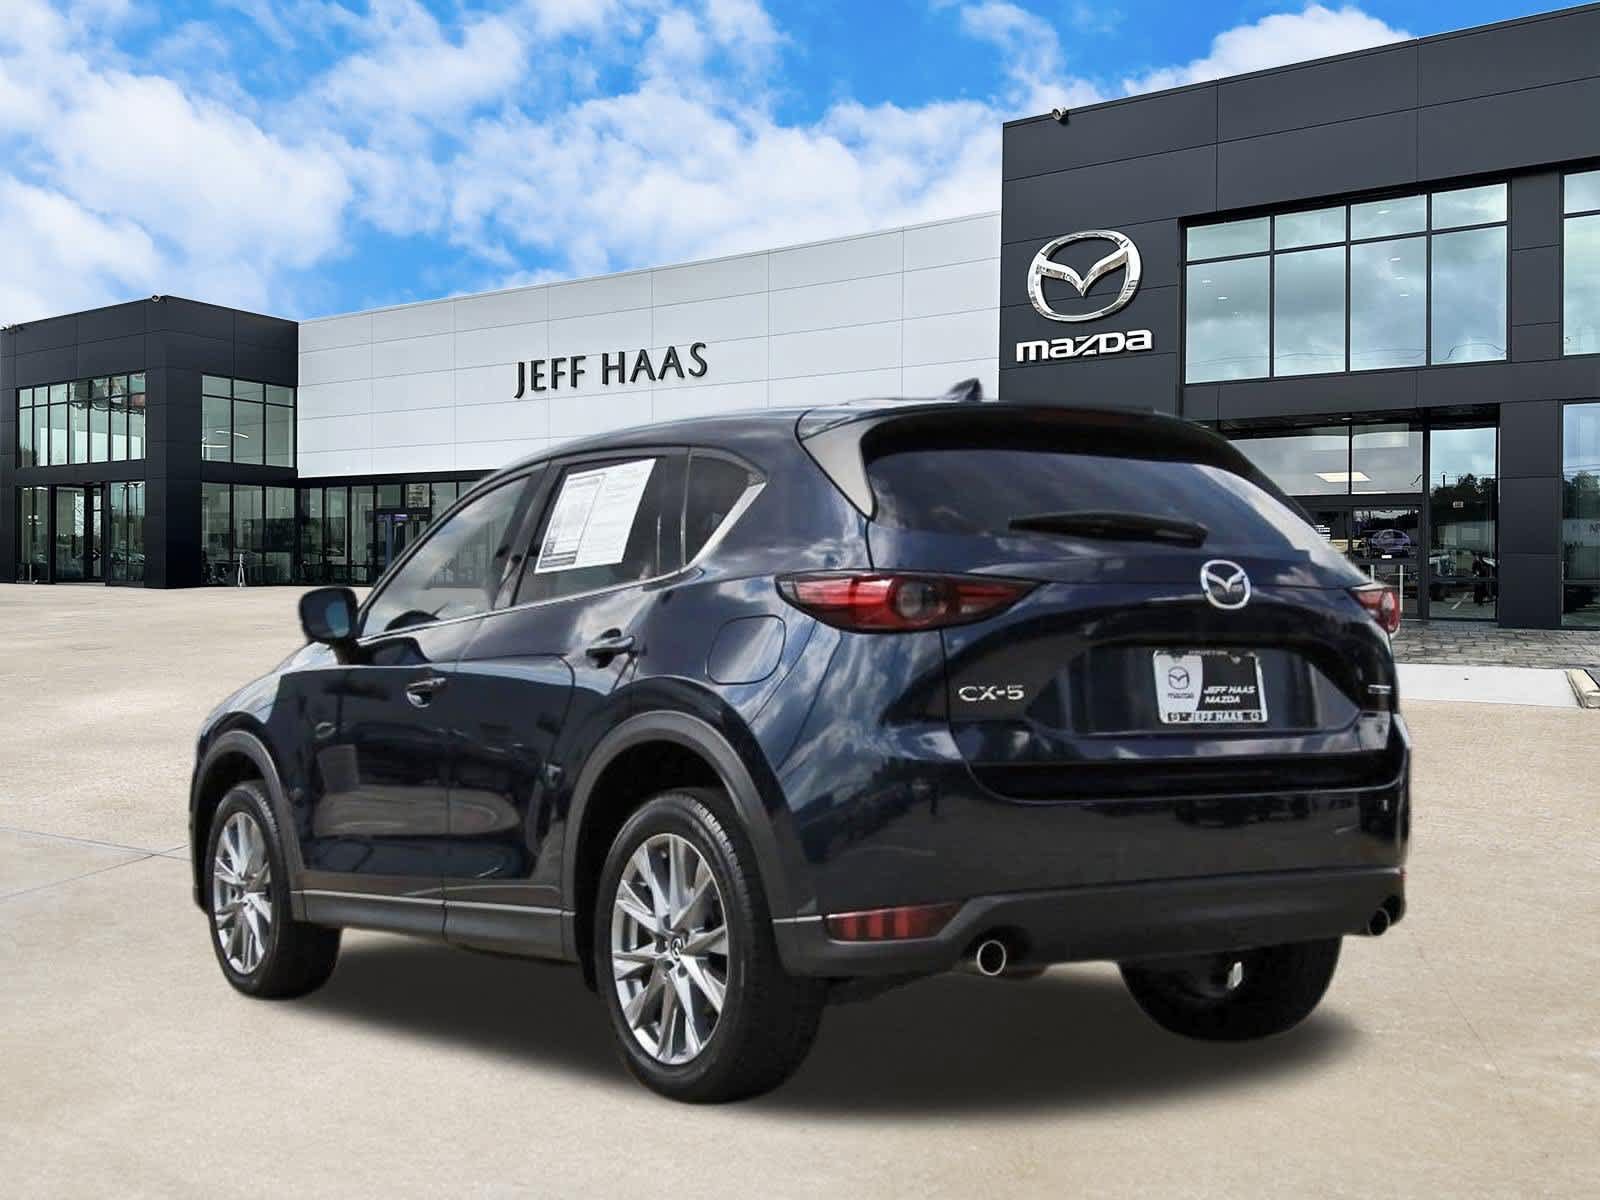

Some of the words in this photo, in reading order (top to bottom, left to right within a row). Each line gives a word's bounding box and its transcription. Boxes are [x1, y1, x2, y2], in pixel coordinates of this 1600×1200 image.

[514, 355, 587, 399] JEFF
[602, 342, 708, 386] HAAS
[958, 684, 1025, 702] CX-5
[1203, 686, 1228, 694] JEFF
[1229, 686, 1256, 694] HAAS
[1205, 695, 1241, 704] MAZDA
[1190, 712, 1213, 721] JEFF
[1216, 712, 1243, 721] HAAS
